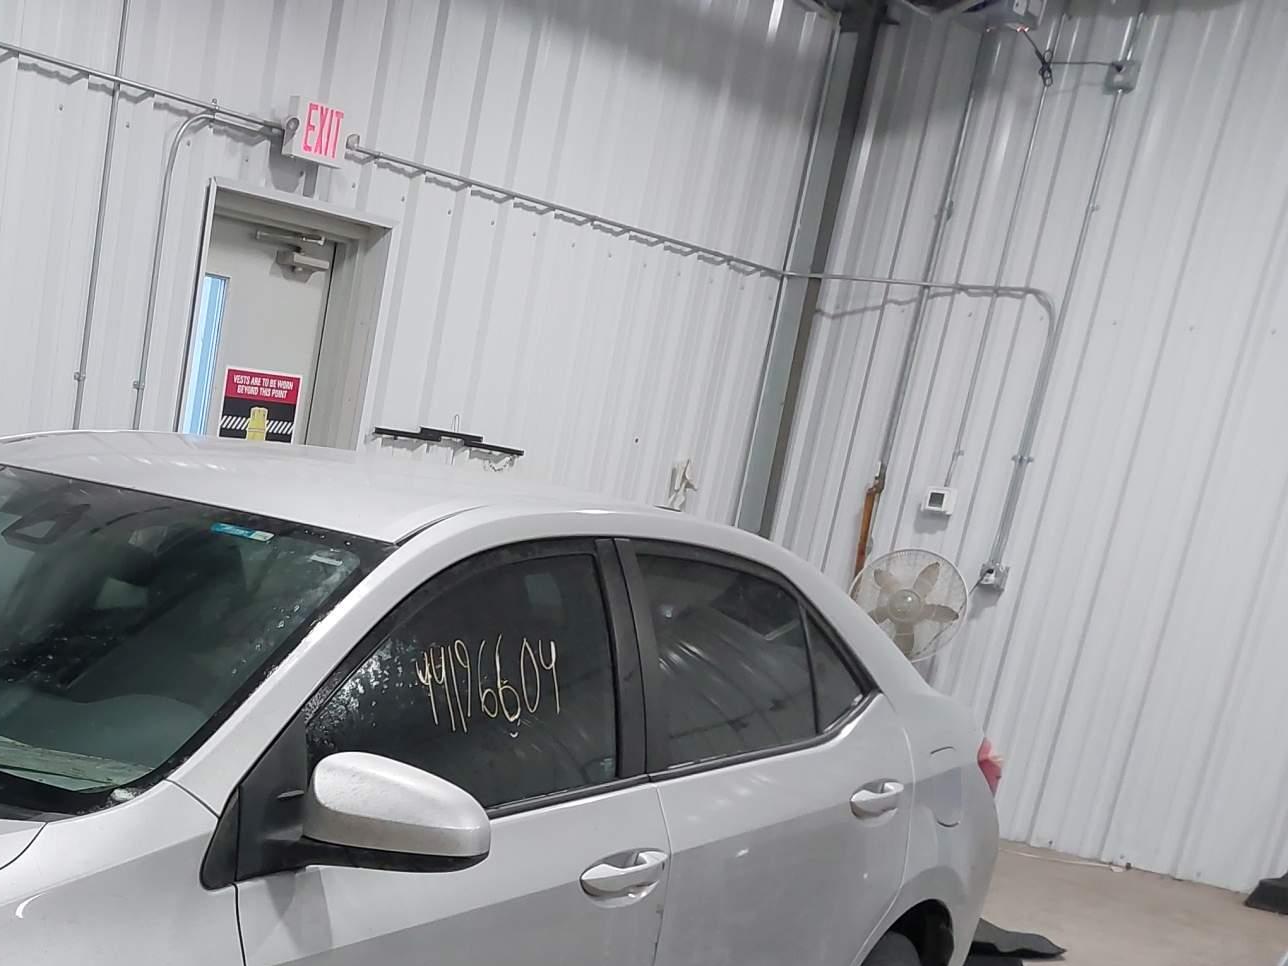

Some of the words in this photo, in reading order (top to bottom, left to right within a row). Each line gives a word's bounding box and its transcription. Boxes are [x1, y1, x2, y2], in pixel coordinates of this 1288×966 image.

[303, 103, 345, 159] EXIT
[233, 375, 251, 384] VESTS
[250, 376, 262, 386] ARE
[262, 378, 270, 387] TO
[269, 379, 278, 388] BE
[277, 380, 294, 391] WORN
[237, 384, 259, 396] BEYOND
[259, 387, 272, 397] THIS
[271, 388, 288, 399] POINT
[416, 634, 560, 733] 44196604
